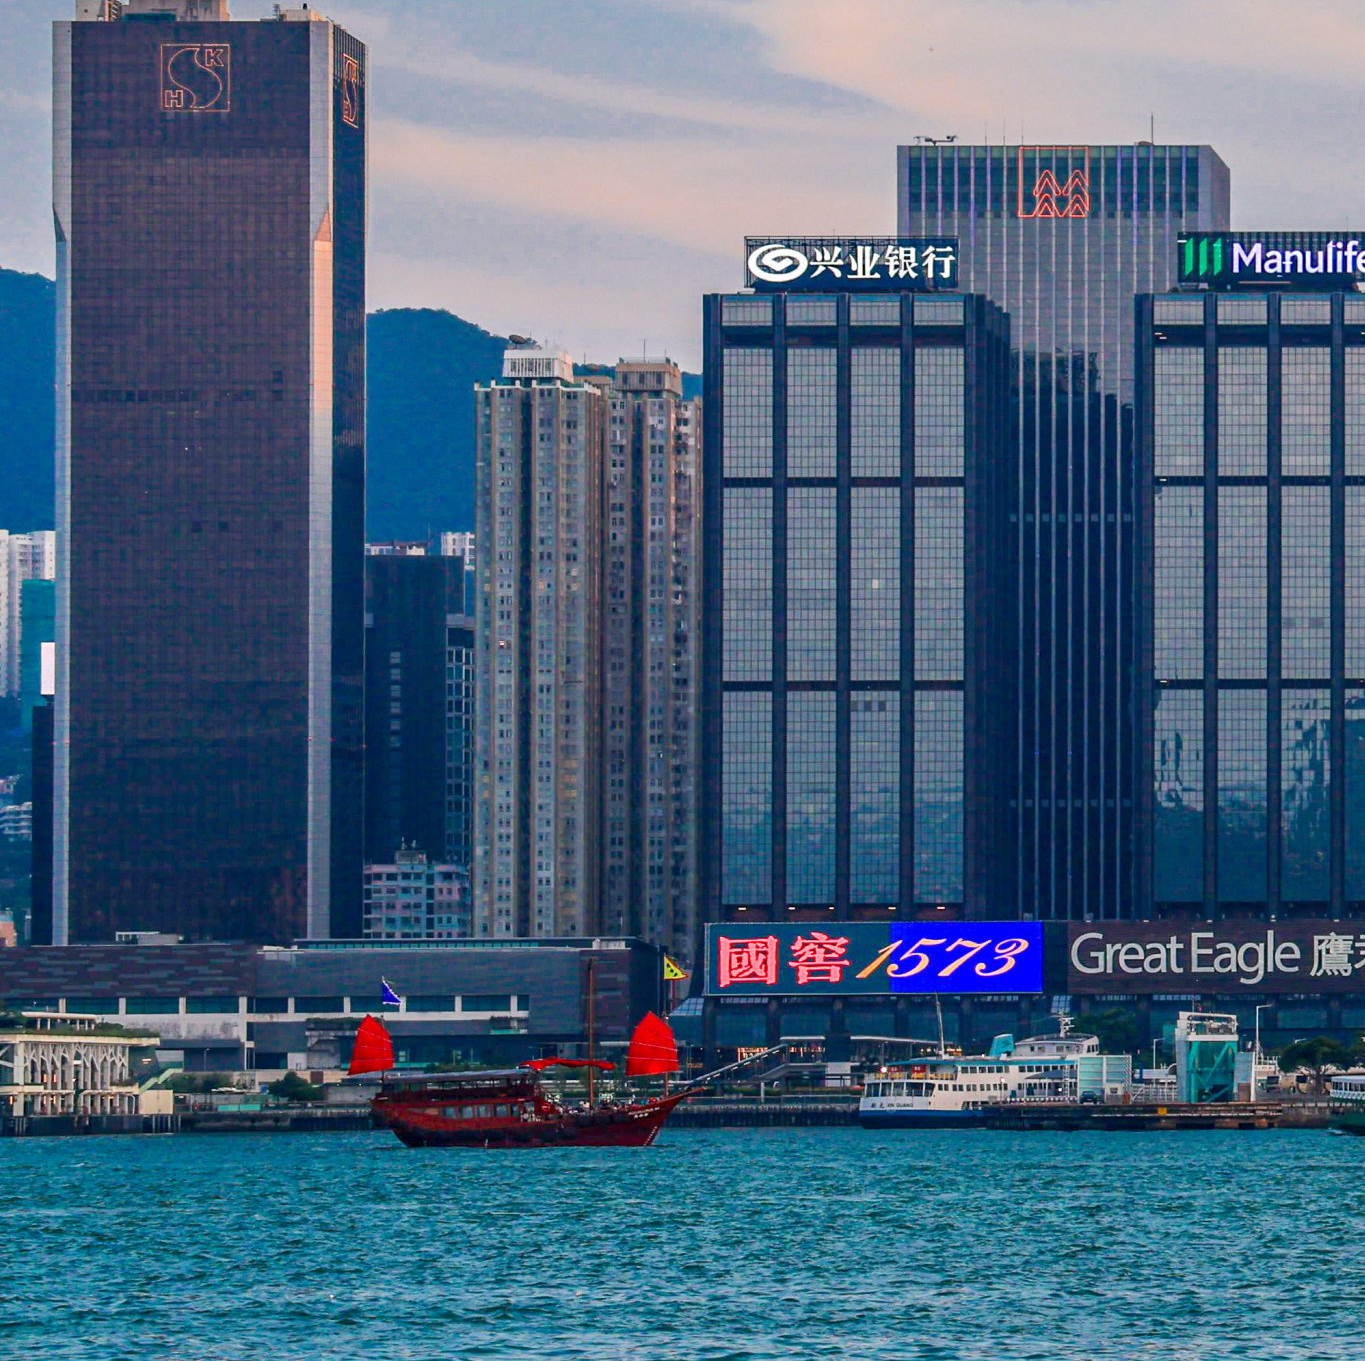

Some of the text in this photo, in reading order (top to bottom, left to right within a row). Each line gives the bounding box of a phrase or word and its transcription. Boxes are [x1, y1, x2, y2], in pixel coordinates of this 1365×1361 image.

[809, 244, 956, 279] 兴业银行
[718, 931, 1030, 988] 國窖 1573
[1070, 932, 1184, 974] Great
[1190, 929, 1301, 985] Eagle
